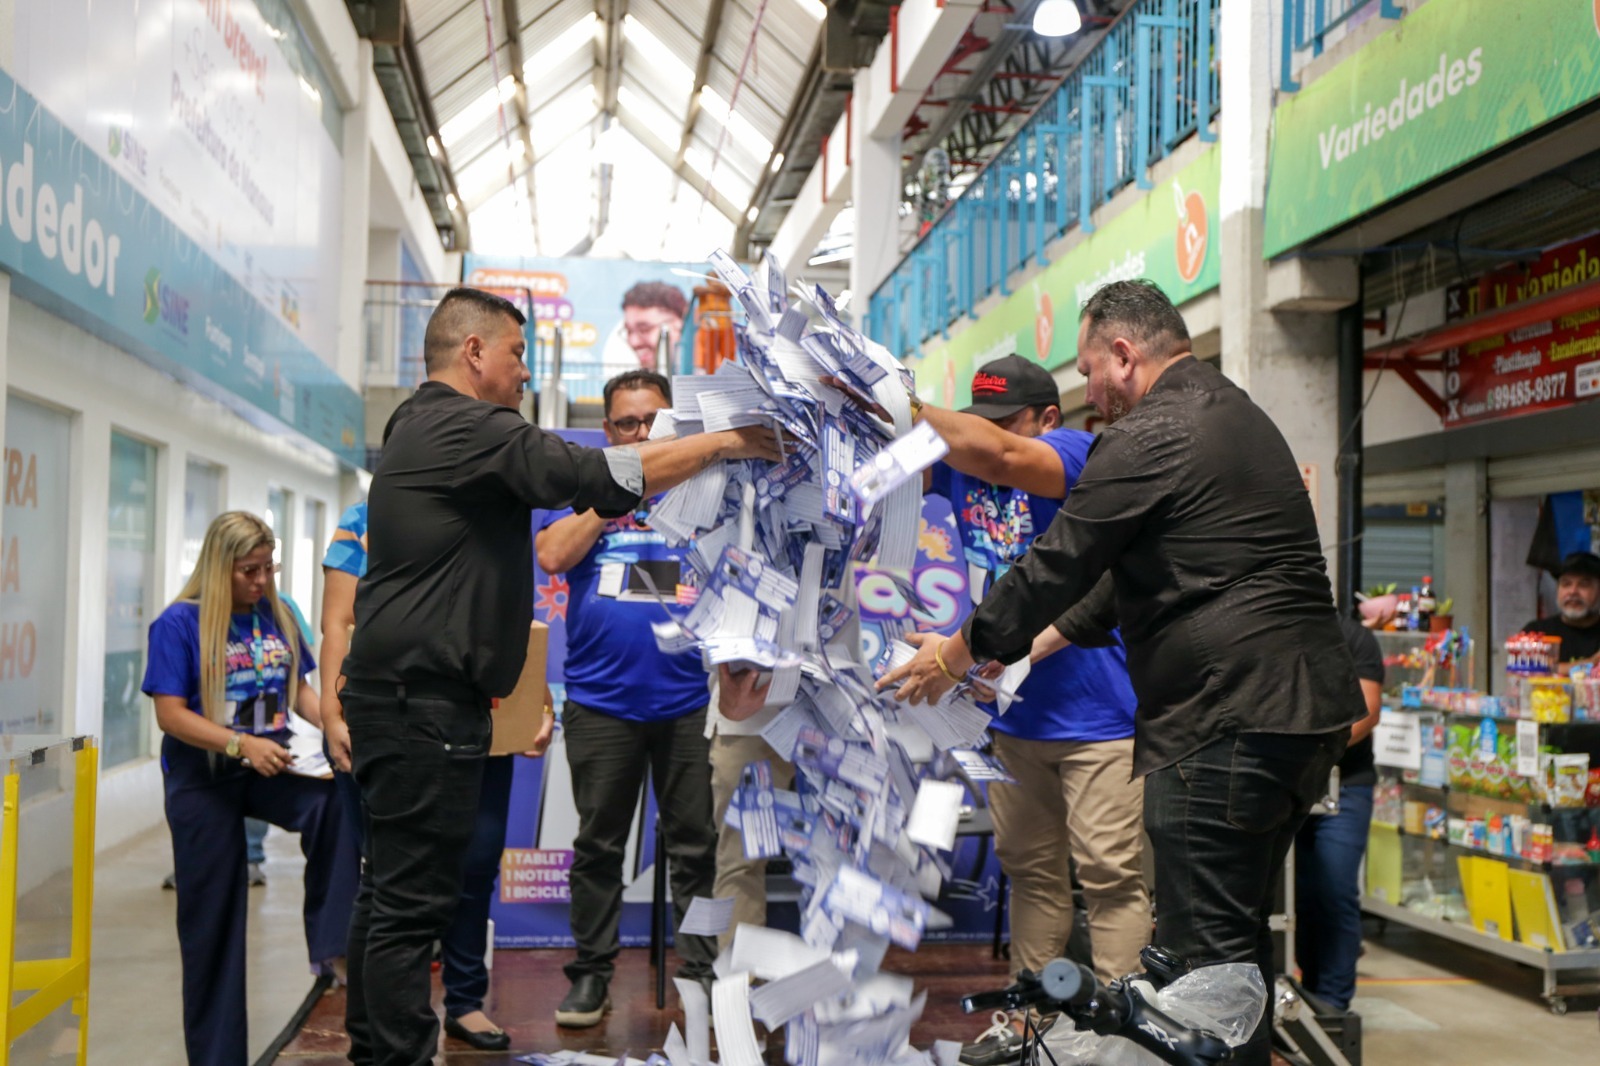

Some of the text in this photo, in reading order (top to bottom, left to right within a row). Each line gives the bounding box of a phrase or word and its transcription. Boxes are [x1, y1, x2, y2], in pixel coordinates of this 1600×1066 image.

[1318, 47, 1484, 170] Variedades
[0, 141, 121, 298] dedor
[161, 284, 190, 336] SINE
[1447, 289, 1461, 421] XROX
[4, 446, 38, 510] RA
[514, 852, 566, 866] TABLET
[513, 886, 572, 899] BICICLE
